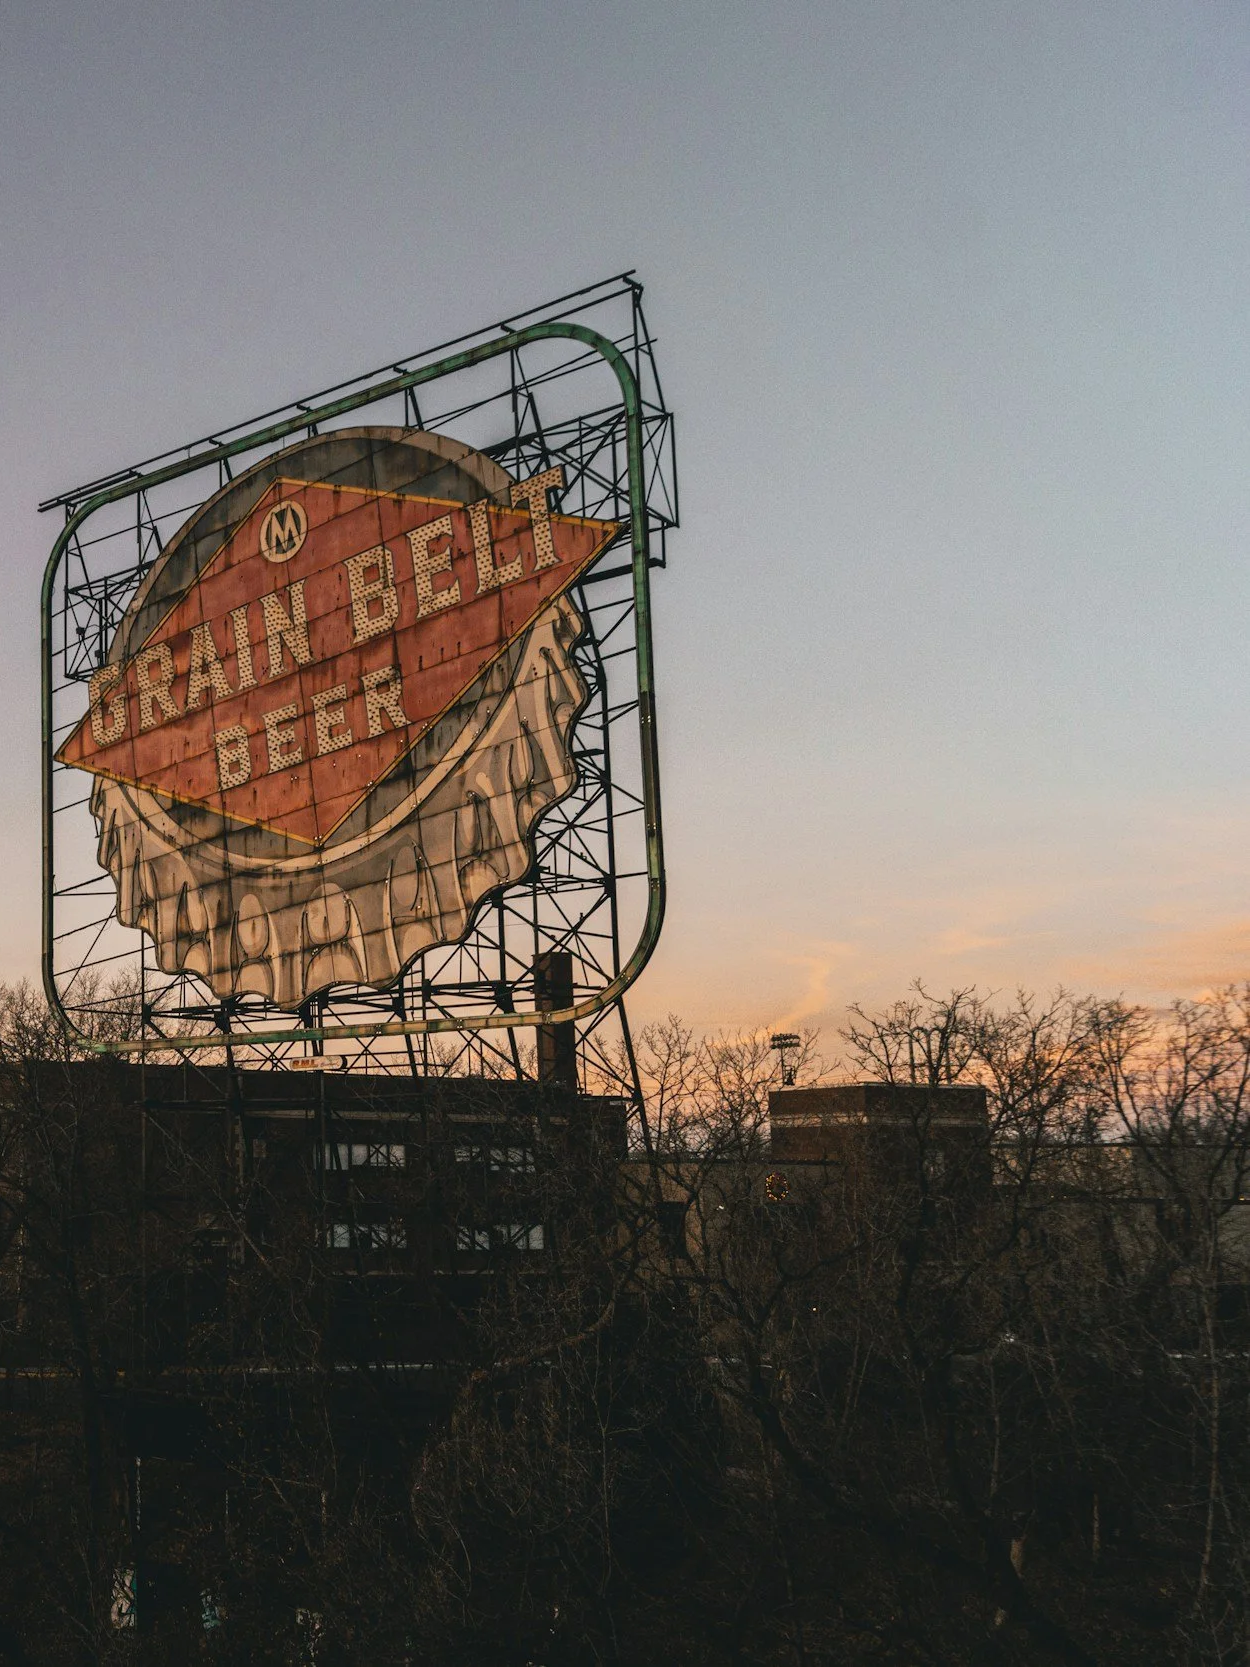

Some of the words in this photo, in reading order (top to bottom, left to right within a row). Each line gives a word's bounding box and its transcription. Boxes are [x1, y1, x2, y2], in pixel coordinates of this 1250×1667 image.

[264, 501, 305, 560] M
[89, 579, 314, 746] GRAIN
[343, 464, 567, 644] BELT
[213, 665, 412, 791] BEER
